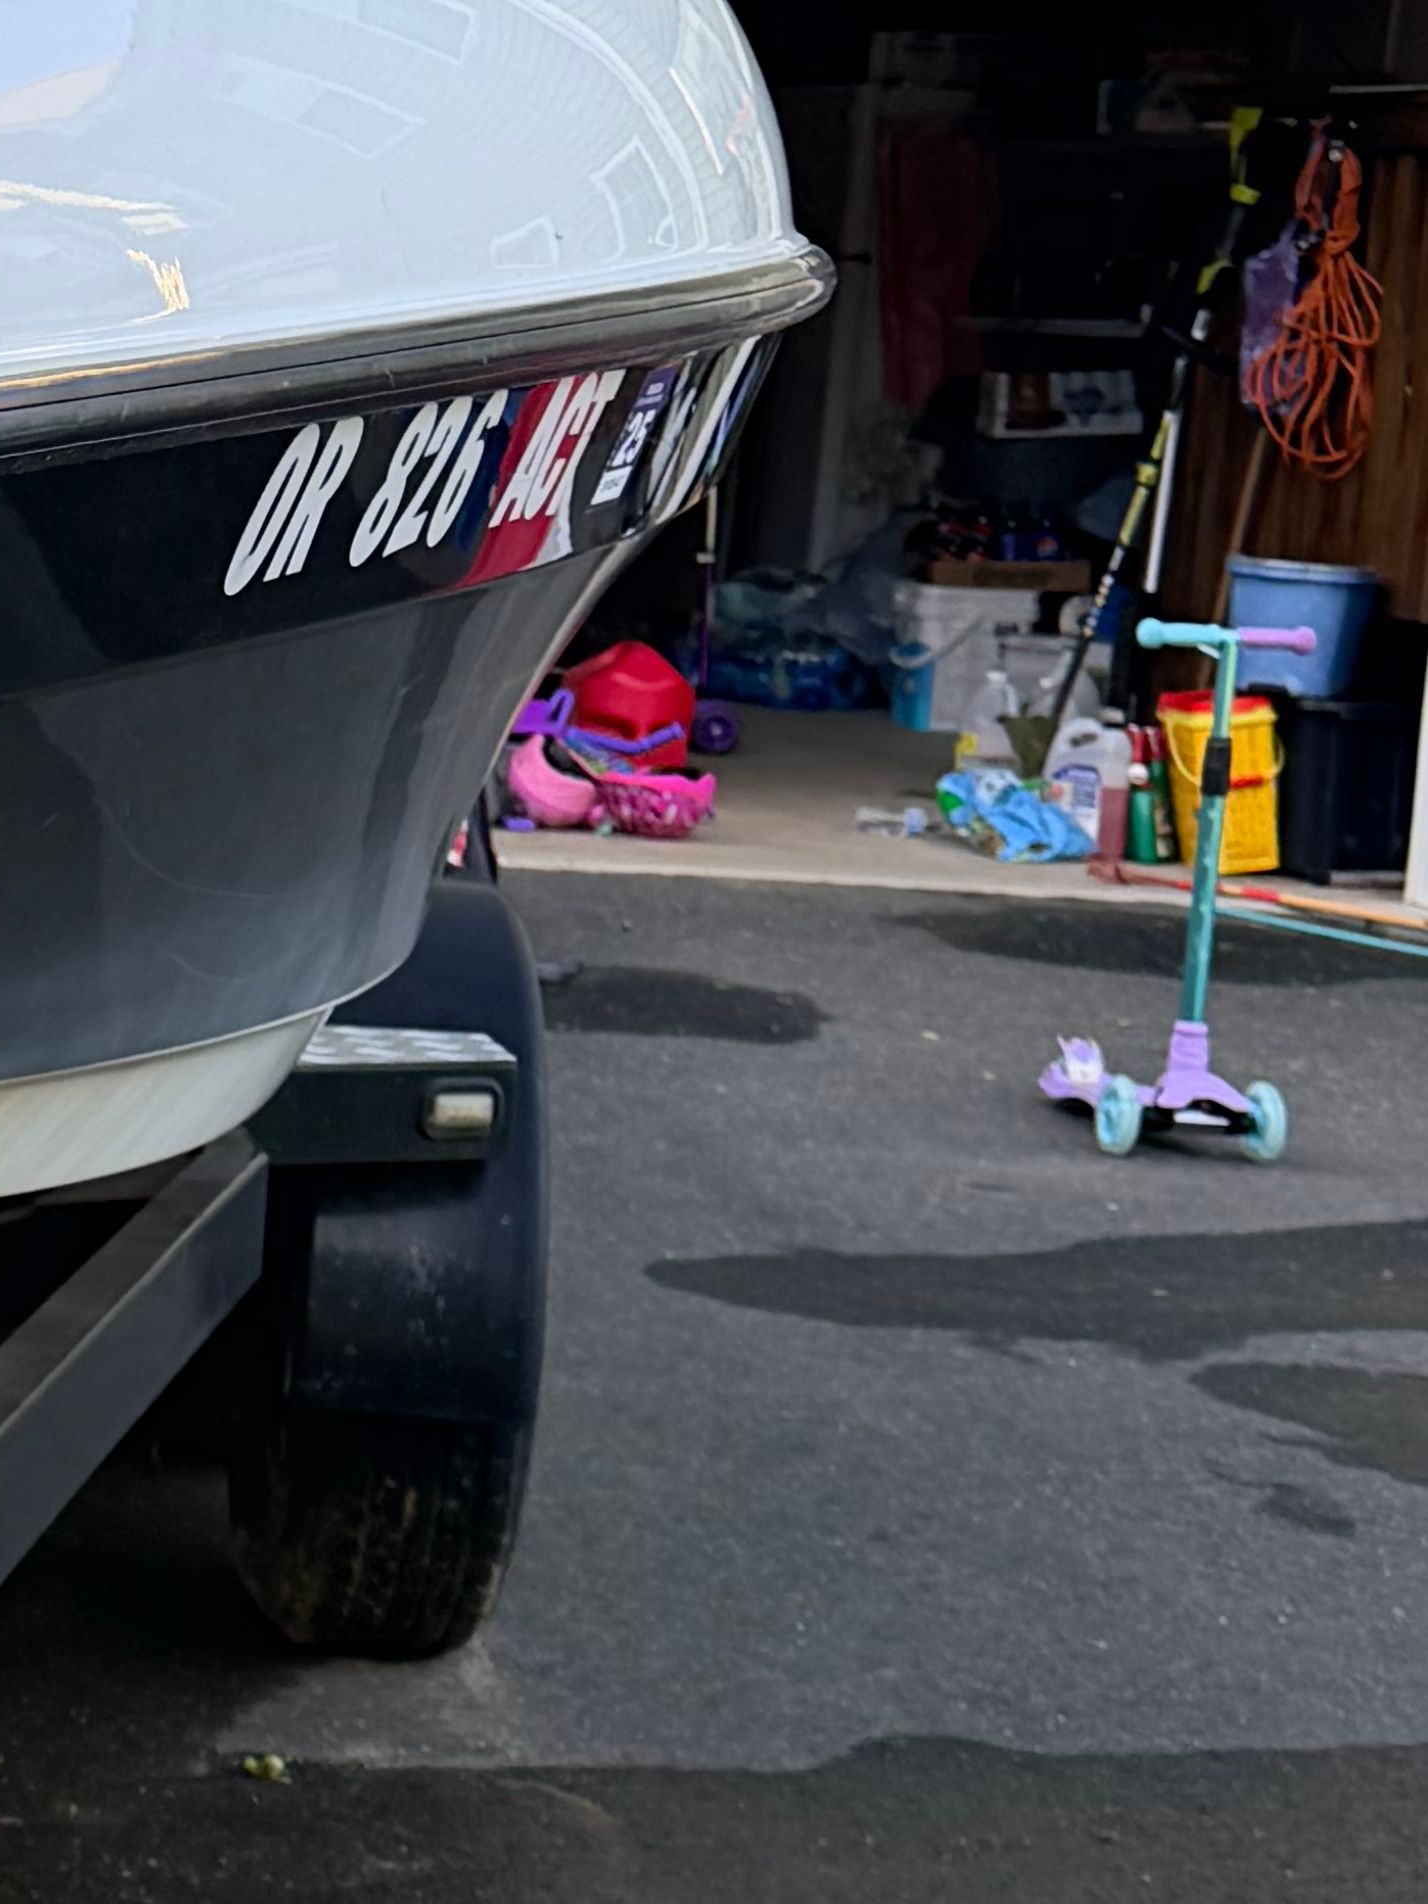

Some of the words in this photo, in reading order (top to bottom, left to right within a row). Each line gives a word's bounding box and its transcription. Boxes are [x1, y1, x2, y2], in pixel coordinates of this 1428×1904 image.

[224, 415, 364, 596] OR
[350, 389, 508, 568] 826
[612, 409, 657, 467] 25
